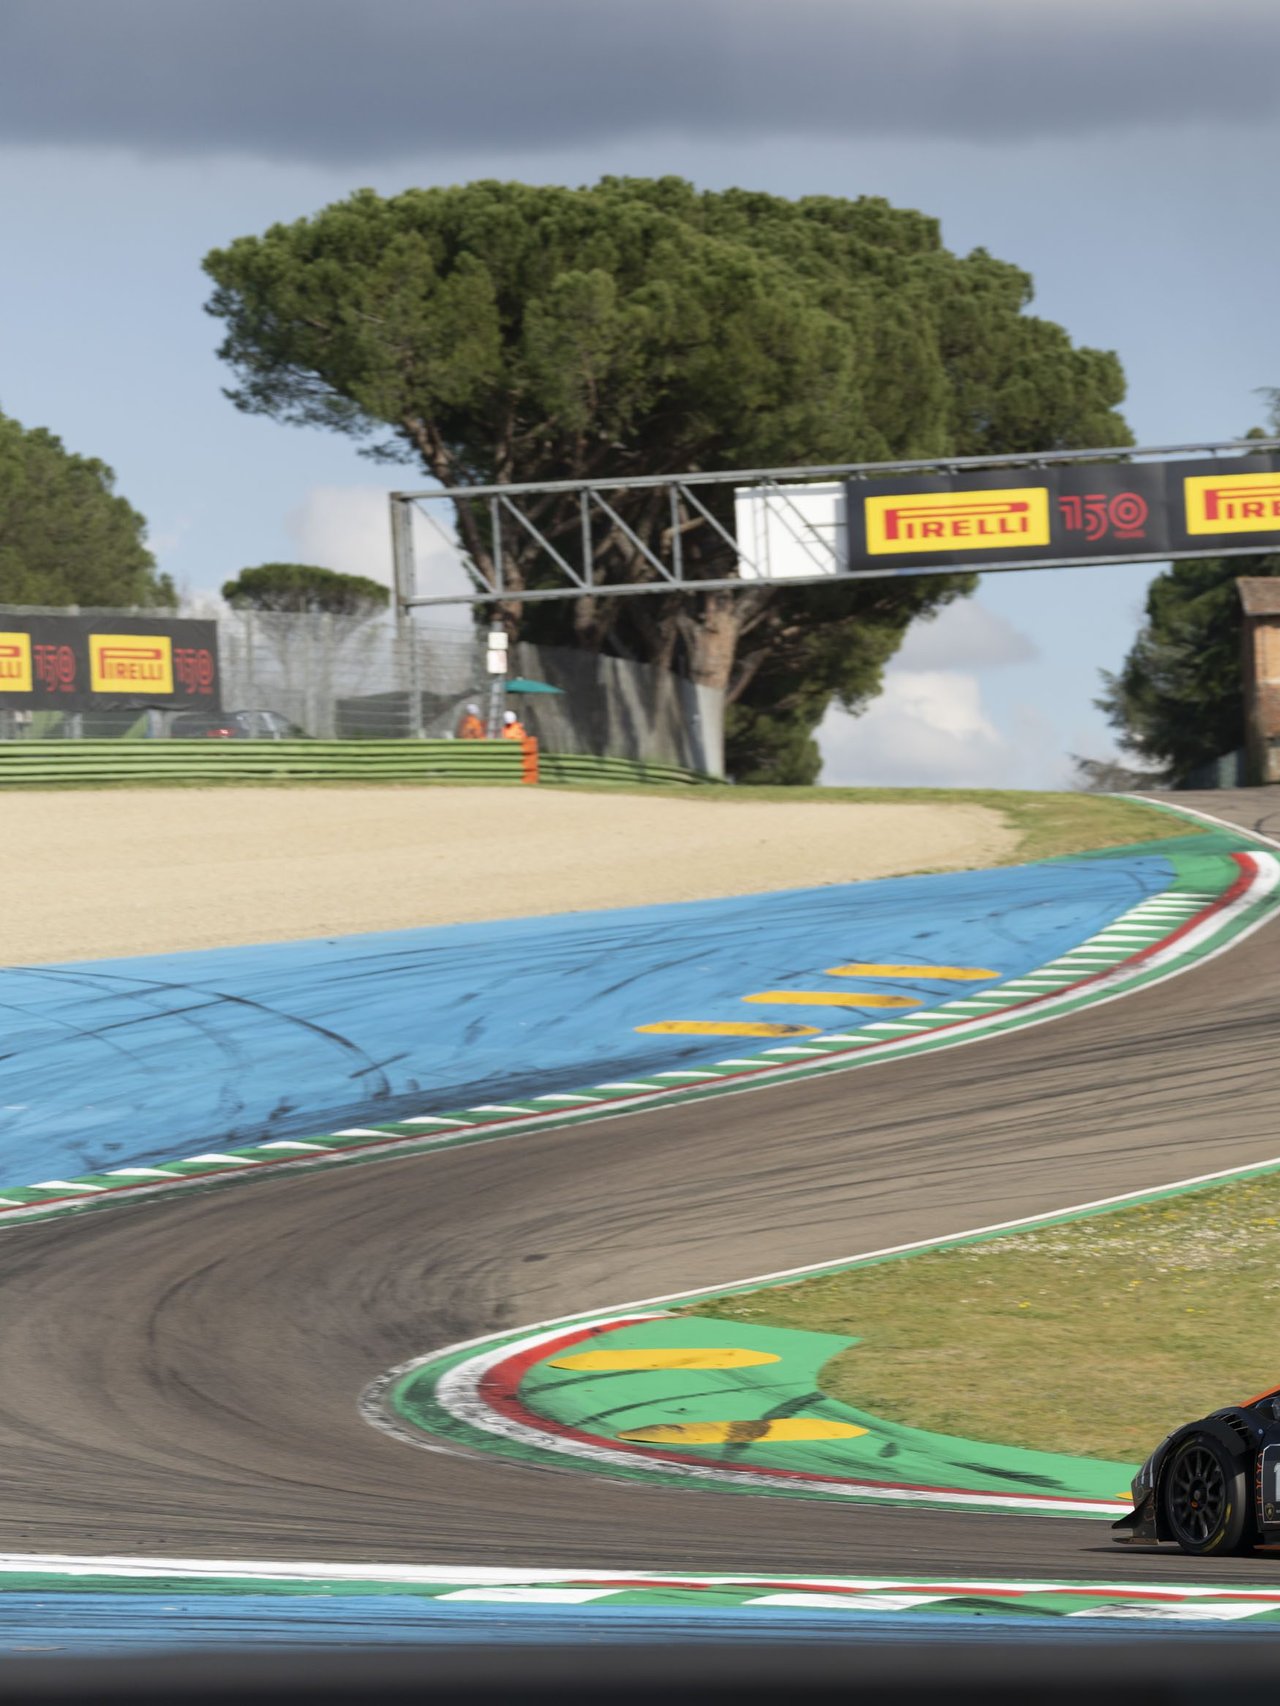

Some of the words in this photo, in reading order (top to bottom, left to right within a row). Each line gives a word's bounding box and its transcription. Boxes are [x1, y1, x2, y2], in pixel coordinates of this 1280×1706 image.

[884, 502, 1030, 541] PIRELLI
[1059, 491, 1148, 541] 150
[99, 647, 164, 680] PIRELLI
